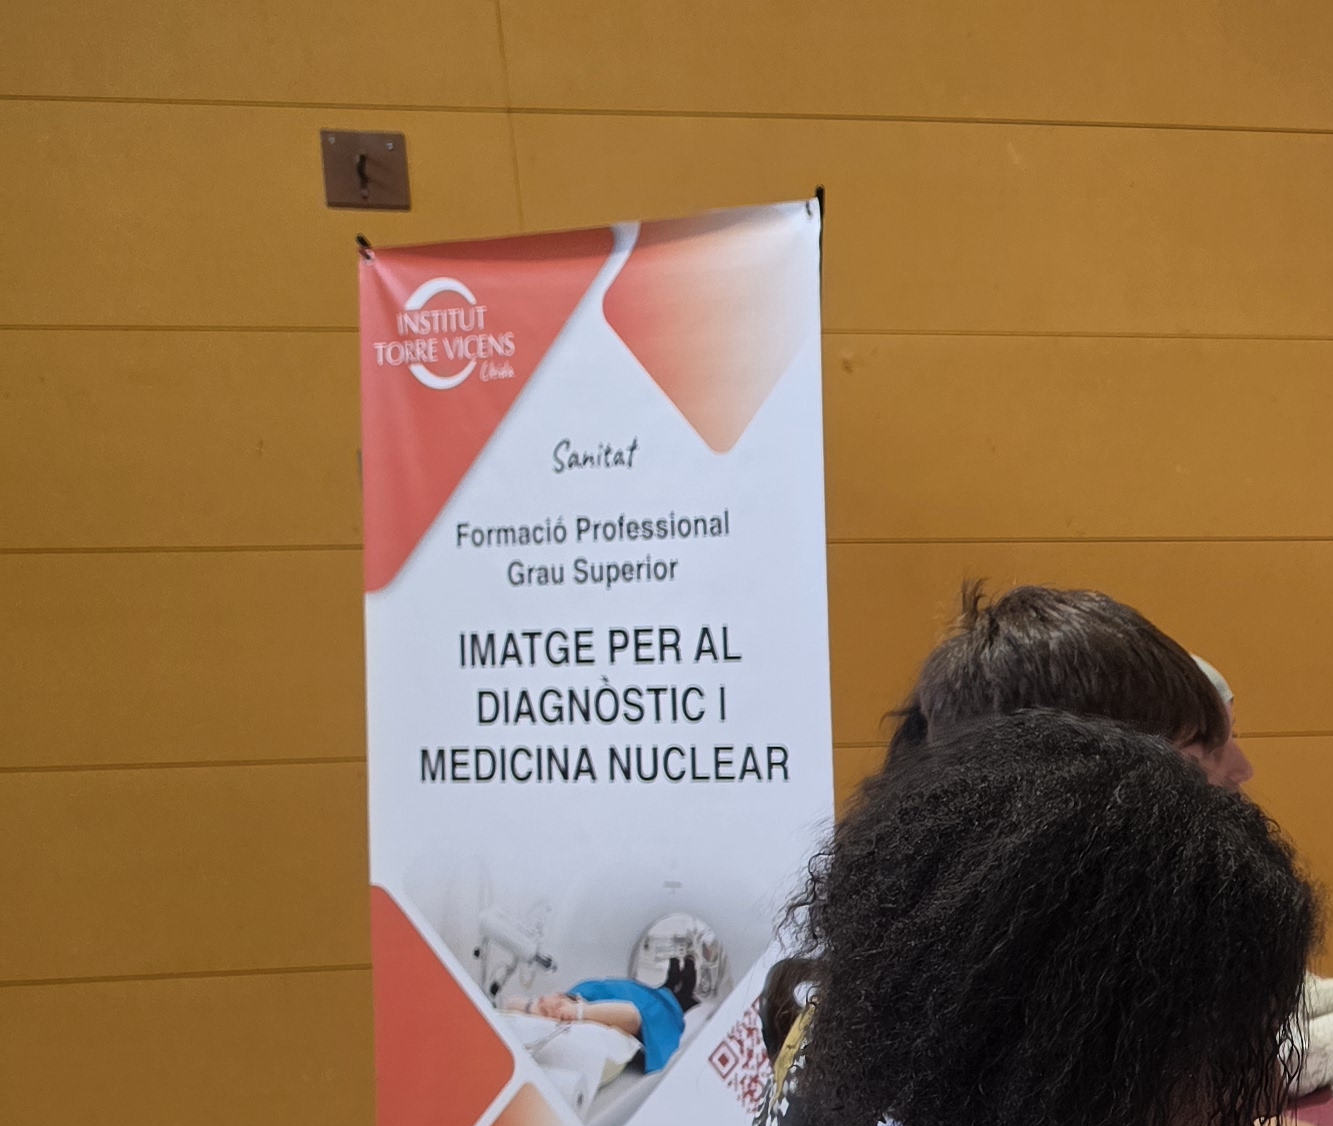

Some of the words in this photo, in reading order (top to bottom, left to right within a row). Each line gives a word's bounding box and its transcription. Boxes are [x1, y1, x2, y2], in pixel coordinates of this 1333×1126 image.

[396, 305, 487, 336] INSTITUT
[373, 338, 439, 366] TORRE
[442, 331, 516, 360] VICENS
[553, 438, 638, 474] Sanitat
[456, 516, 567, 548] Formació
[576, 510, 730, 542] Professional
[507, 560, 565, 587] Grau
[573, 555, 679, 589] Superior
[459, 629, 596, 668] IMATGE
[608, 627, 682, 665] PER
[694, 626, 742, 662] AL
[477, 675, 706, 724] DIAGNÒSTIC
[719, 686, 727, 722] I
[420, 747, 597, 783] MEDICINA
[608, 746, 789, 782] NUCLEAR
